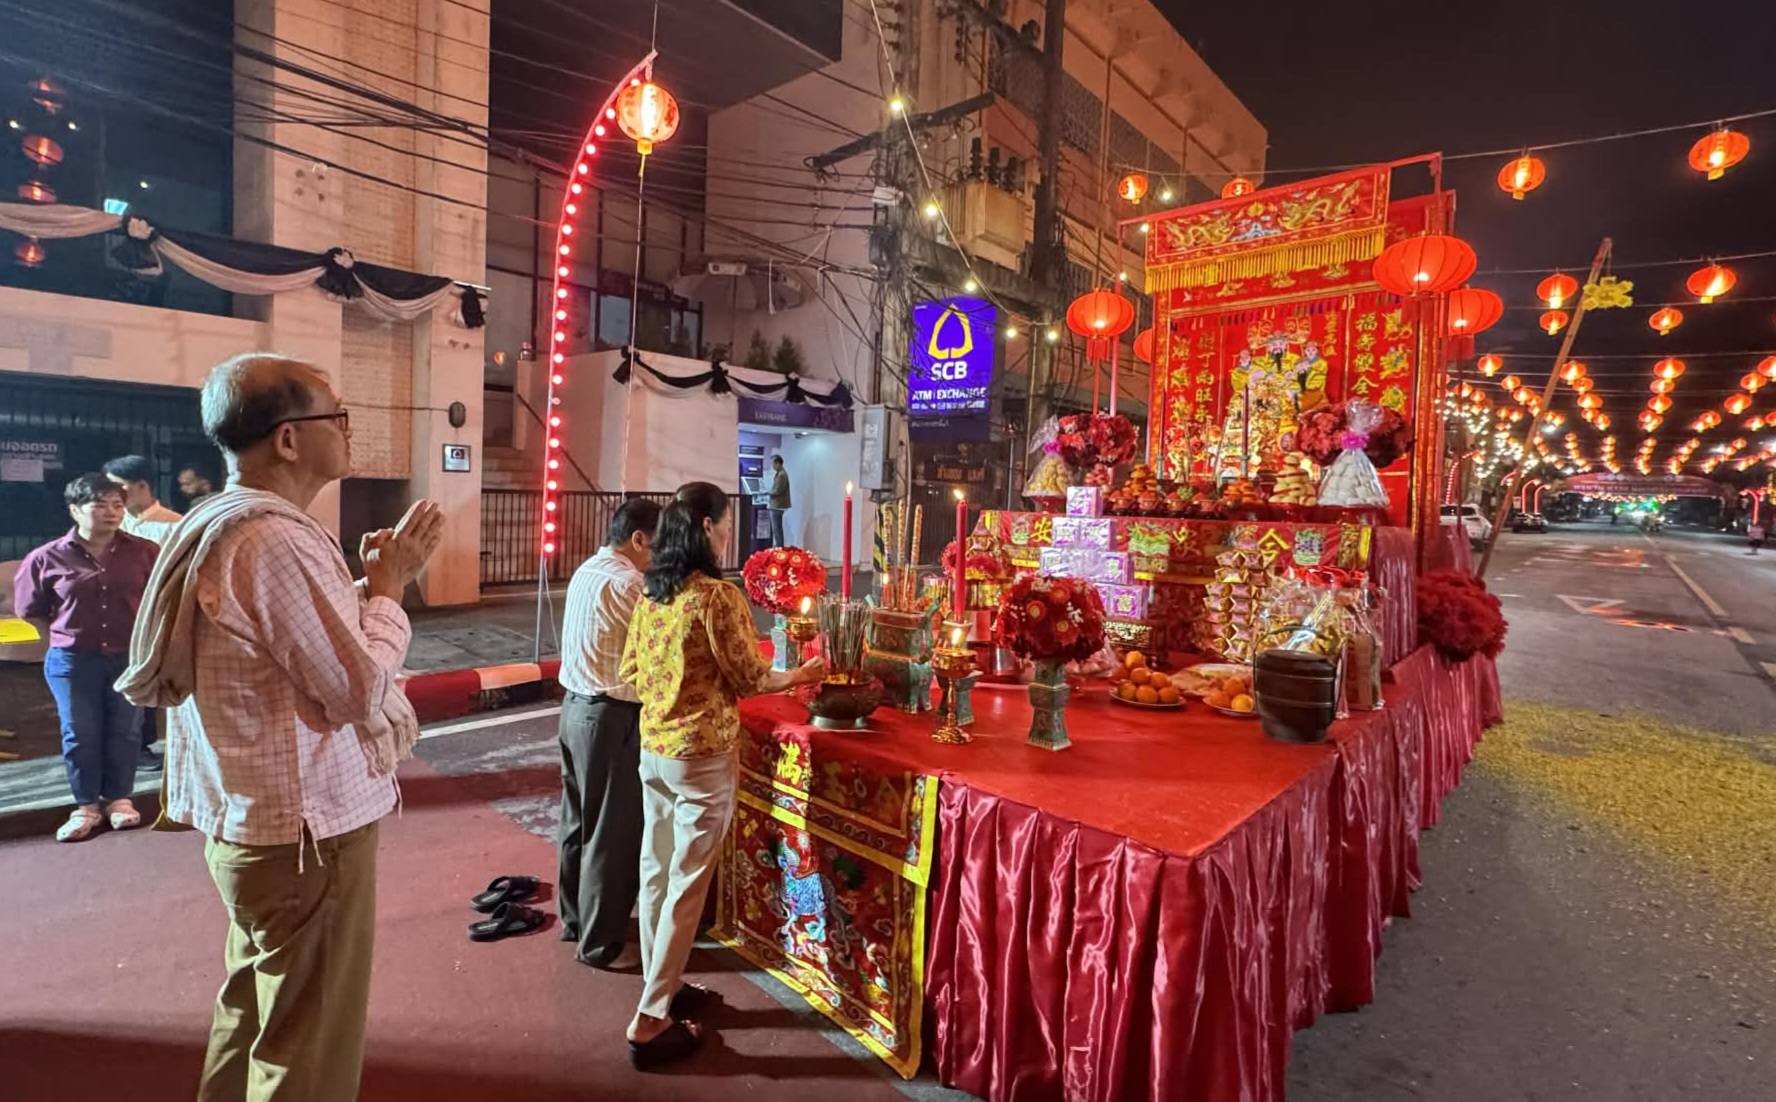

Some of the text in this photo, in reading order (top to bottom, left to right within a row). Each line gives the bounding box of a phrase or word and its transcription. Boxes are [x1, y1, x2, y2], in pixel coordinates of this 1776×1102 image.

[931, 361, 967, 381] SCB
[912, 387, 986, 401] ATM EXCHANGE
